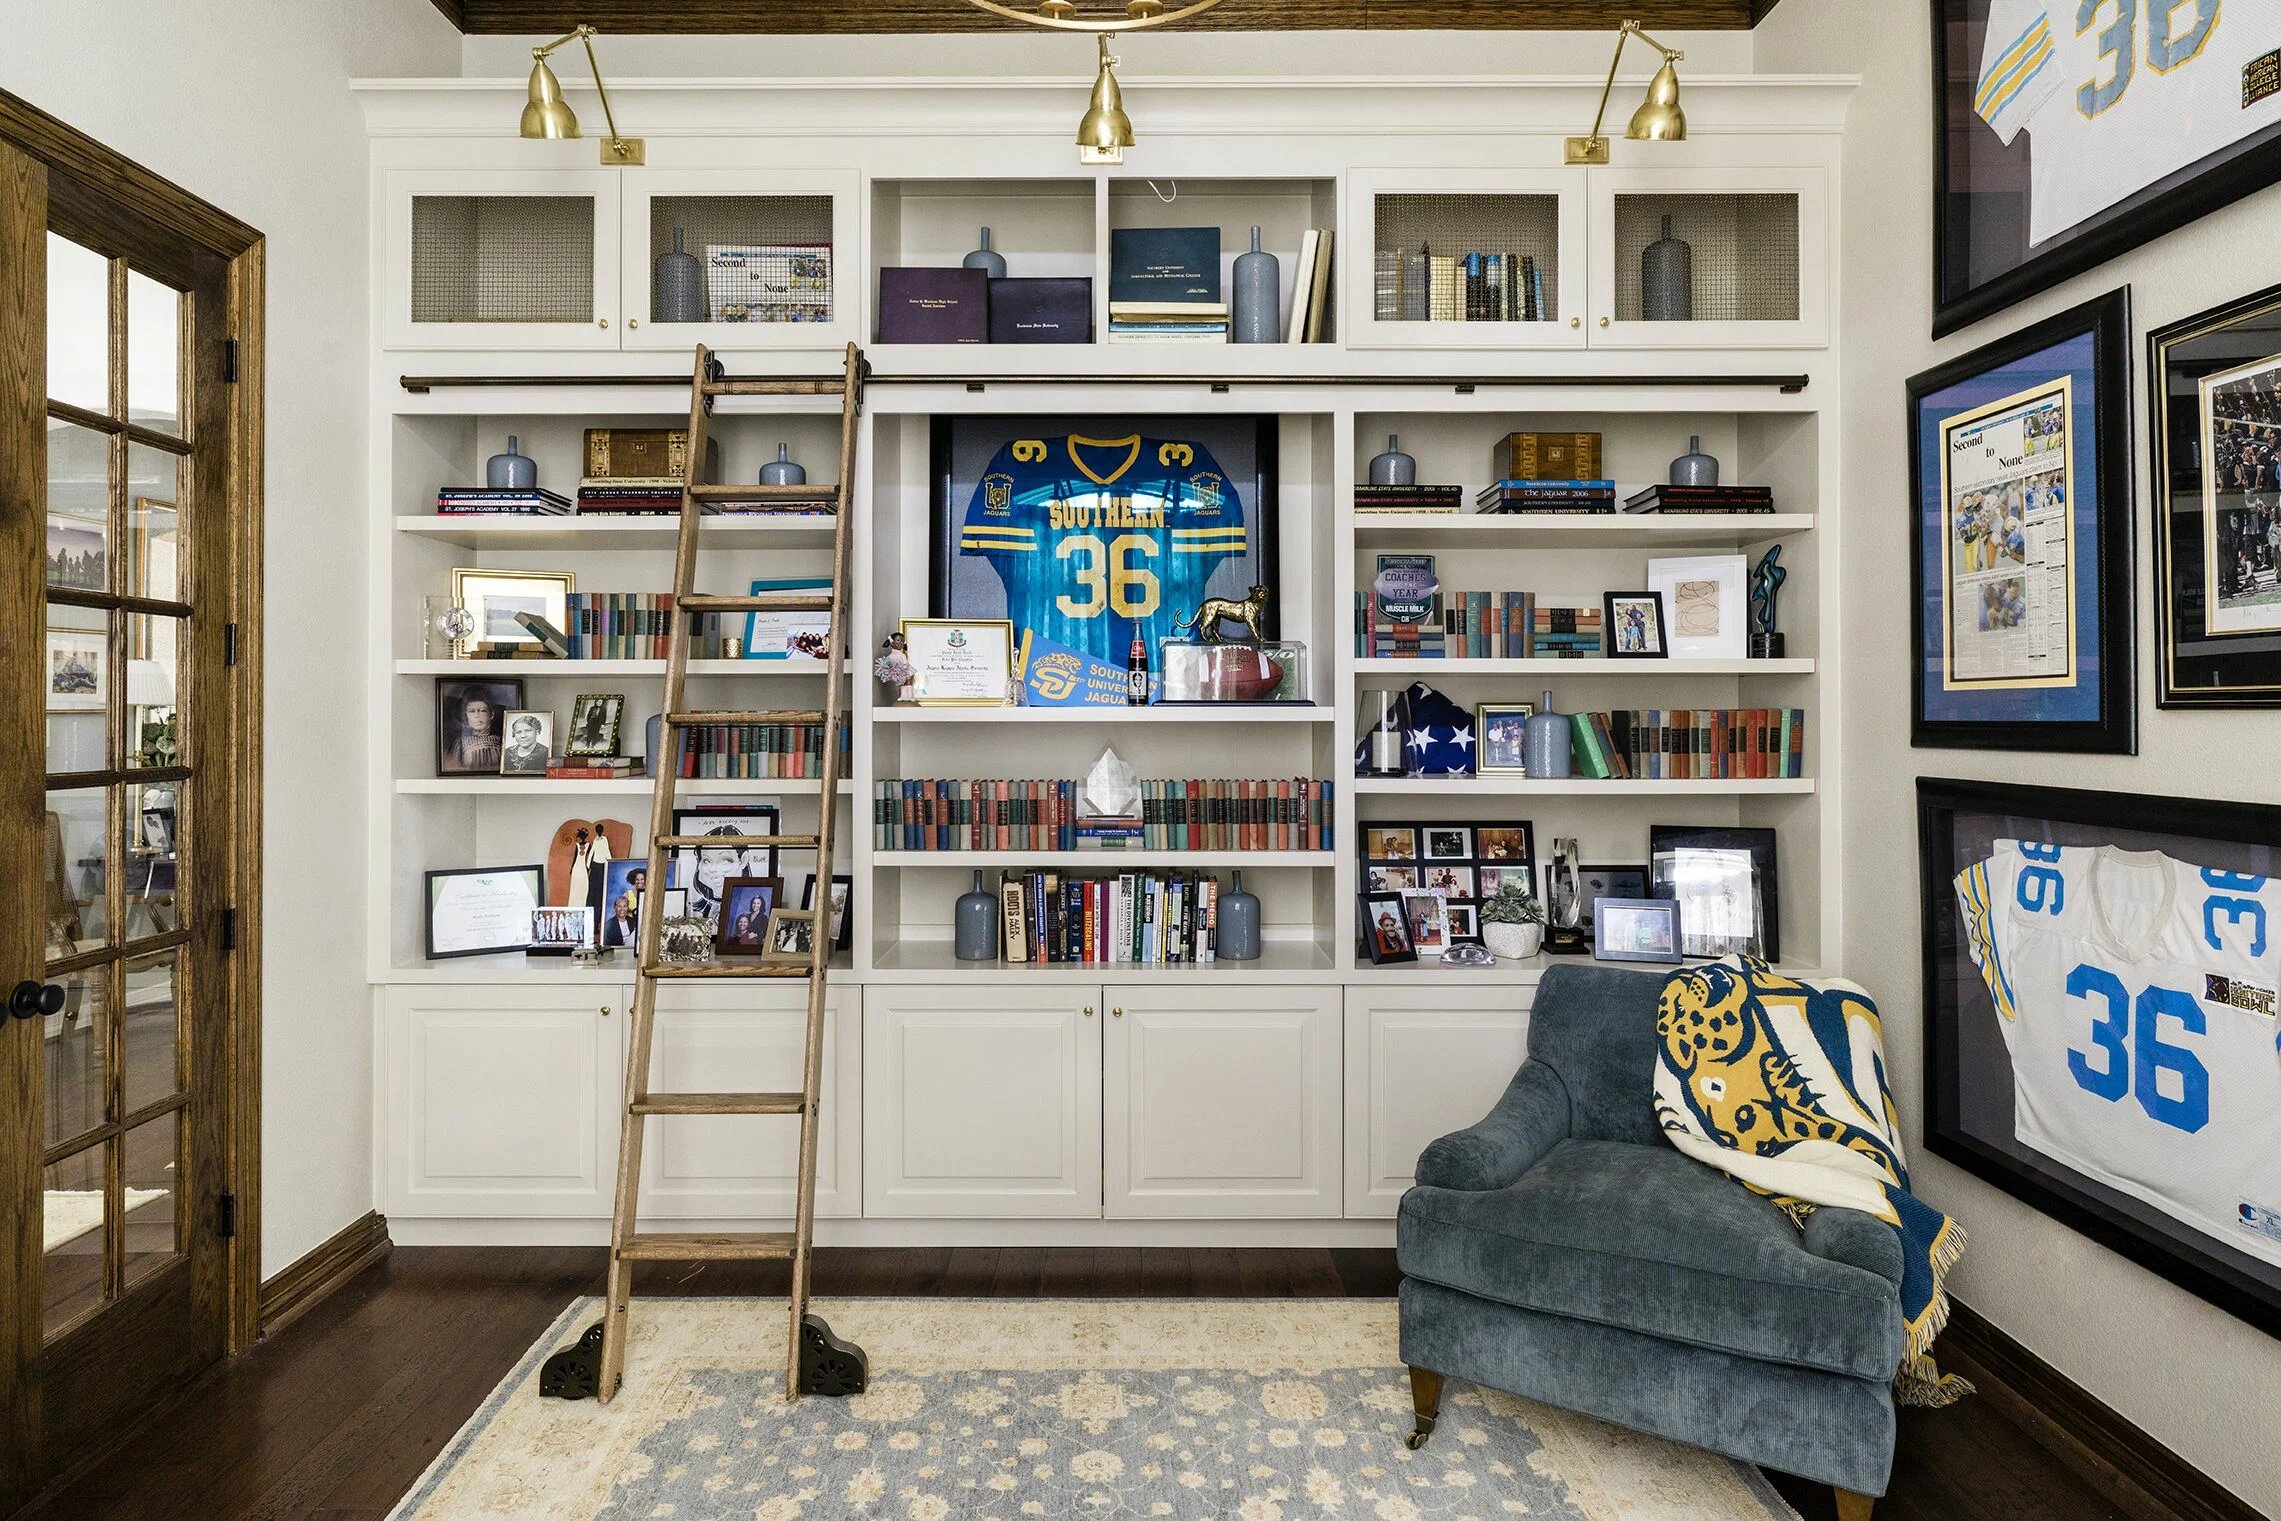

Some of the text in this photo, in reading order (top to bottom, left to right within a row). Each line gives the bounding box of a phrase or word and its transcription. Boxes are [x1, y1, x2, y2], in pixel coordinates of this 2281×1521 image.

[711, 257, 746, 268] Second
[750, 271, 760, 280] to
[764, 283, 789, 293] None
[1953, 433, 1983, 453] Second
[1985, 448, 1995, 457] to
[1999, 455, 2024, 470] None
[984, 472, 1014, 483] SOUTHERN
[1190, 471, 1222, 482] SOUTHERN
[983, 509, 1011, 517] JAGUARS
[1050, 497, 1166, 529] SOUTHERN
[1056, 535, 1160, 618] 36
[1385, 573, 1426, 582] COACHES
[1392, 589, 1419, 598] YEAR
[1409, 604, 1425, 612] MILK
[1089, 663, 1157, 690] SOUTHN
[1087, 678, 1155, 699] UNIVERY
[1084, 691, 1127, 705] JAGUA
[1007, 890, 1020, 916] ROOTS
[2230, 994, 2276, 1016] BOWL
[2066, 963, 2210, 1135] 36
